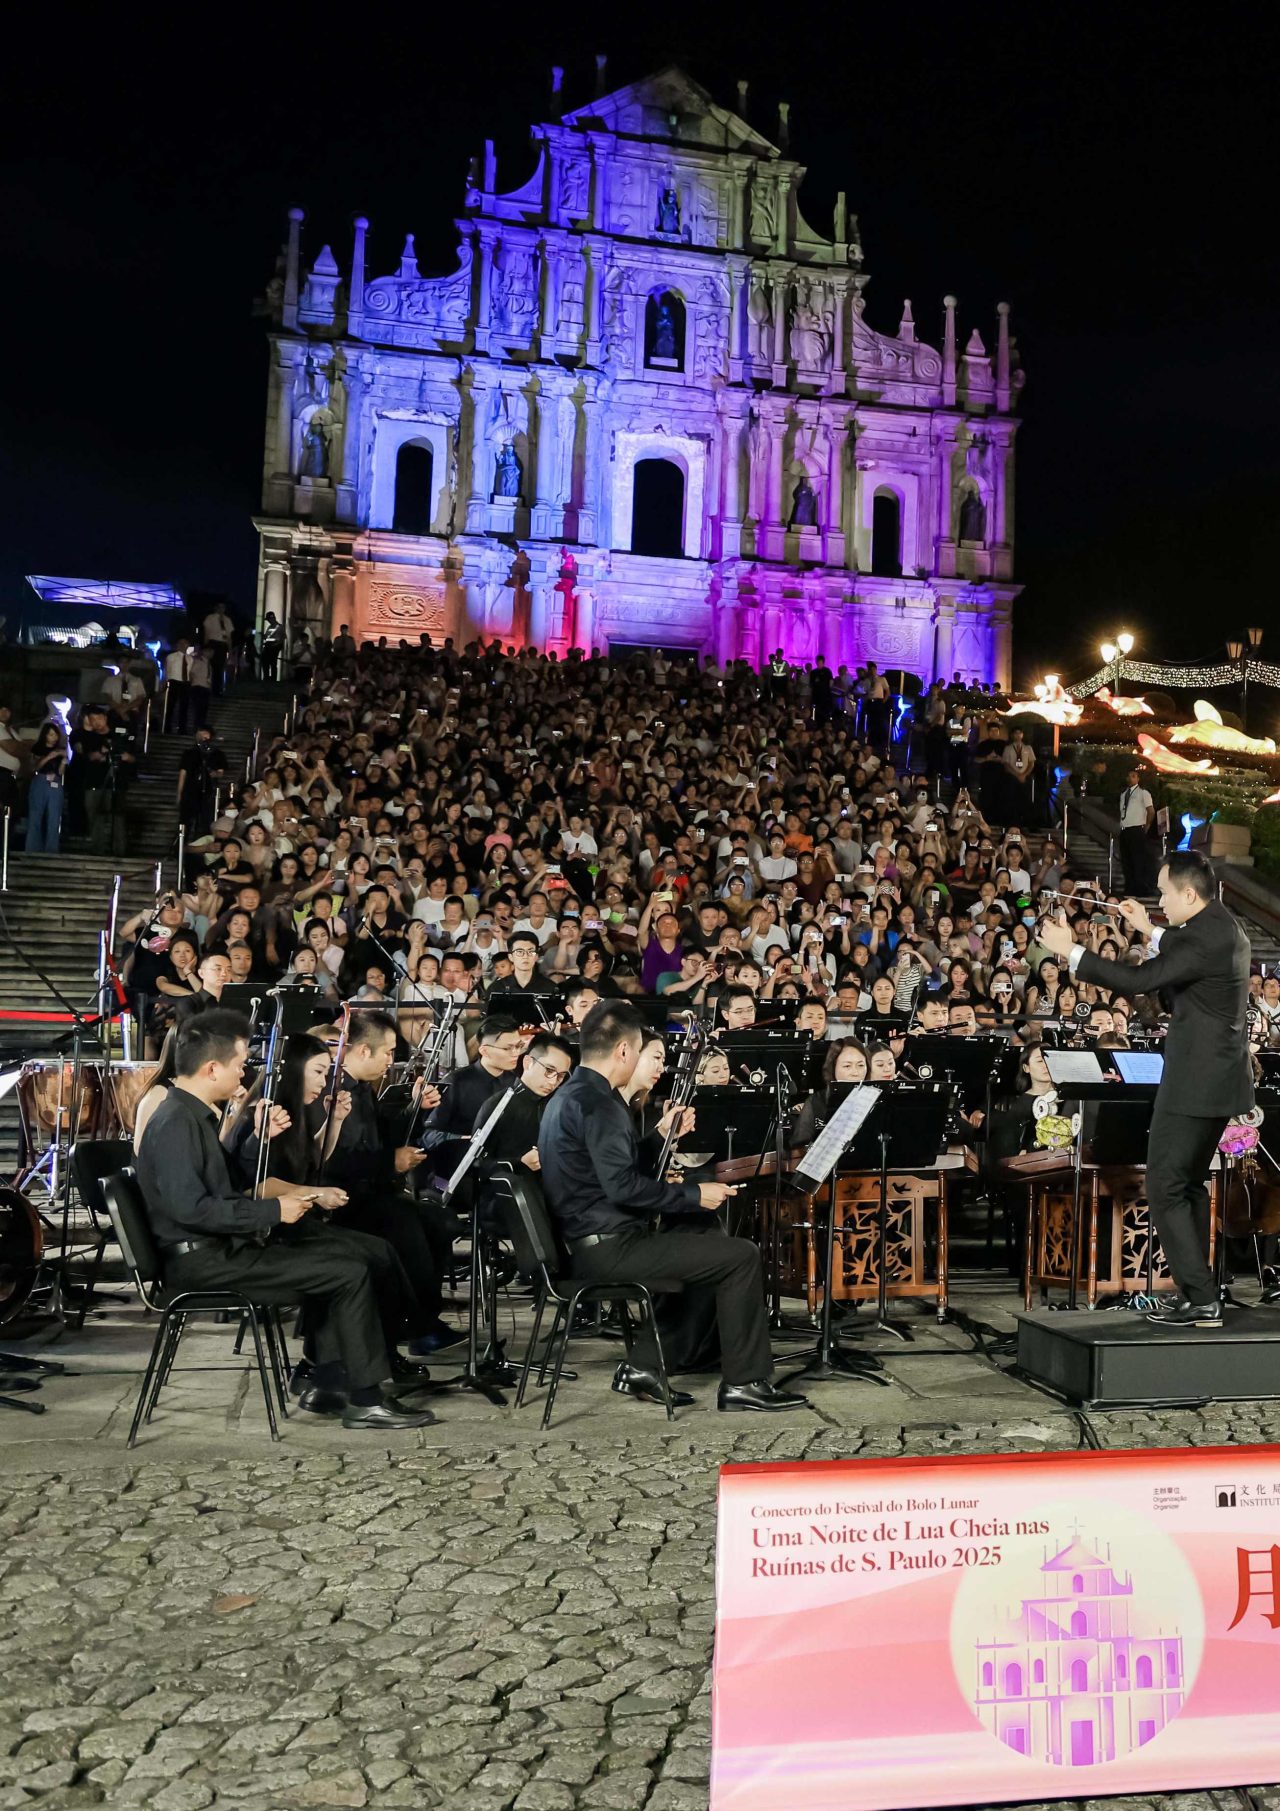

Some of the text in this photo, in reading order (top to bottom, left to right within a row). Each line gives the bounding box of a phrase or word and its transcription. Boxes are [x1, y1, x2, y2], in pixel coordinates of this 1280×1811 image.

[751, 1498, 980, 1518] Concerto do Festival do Bolo Lunar
[752, 1518, 1050, 1547] Uma Noite de Lua Cheia nas
[751, 1546, 1002, 1578] Ruínas de S. Paulo 2025
